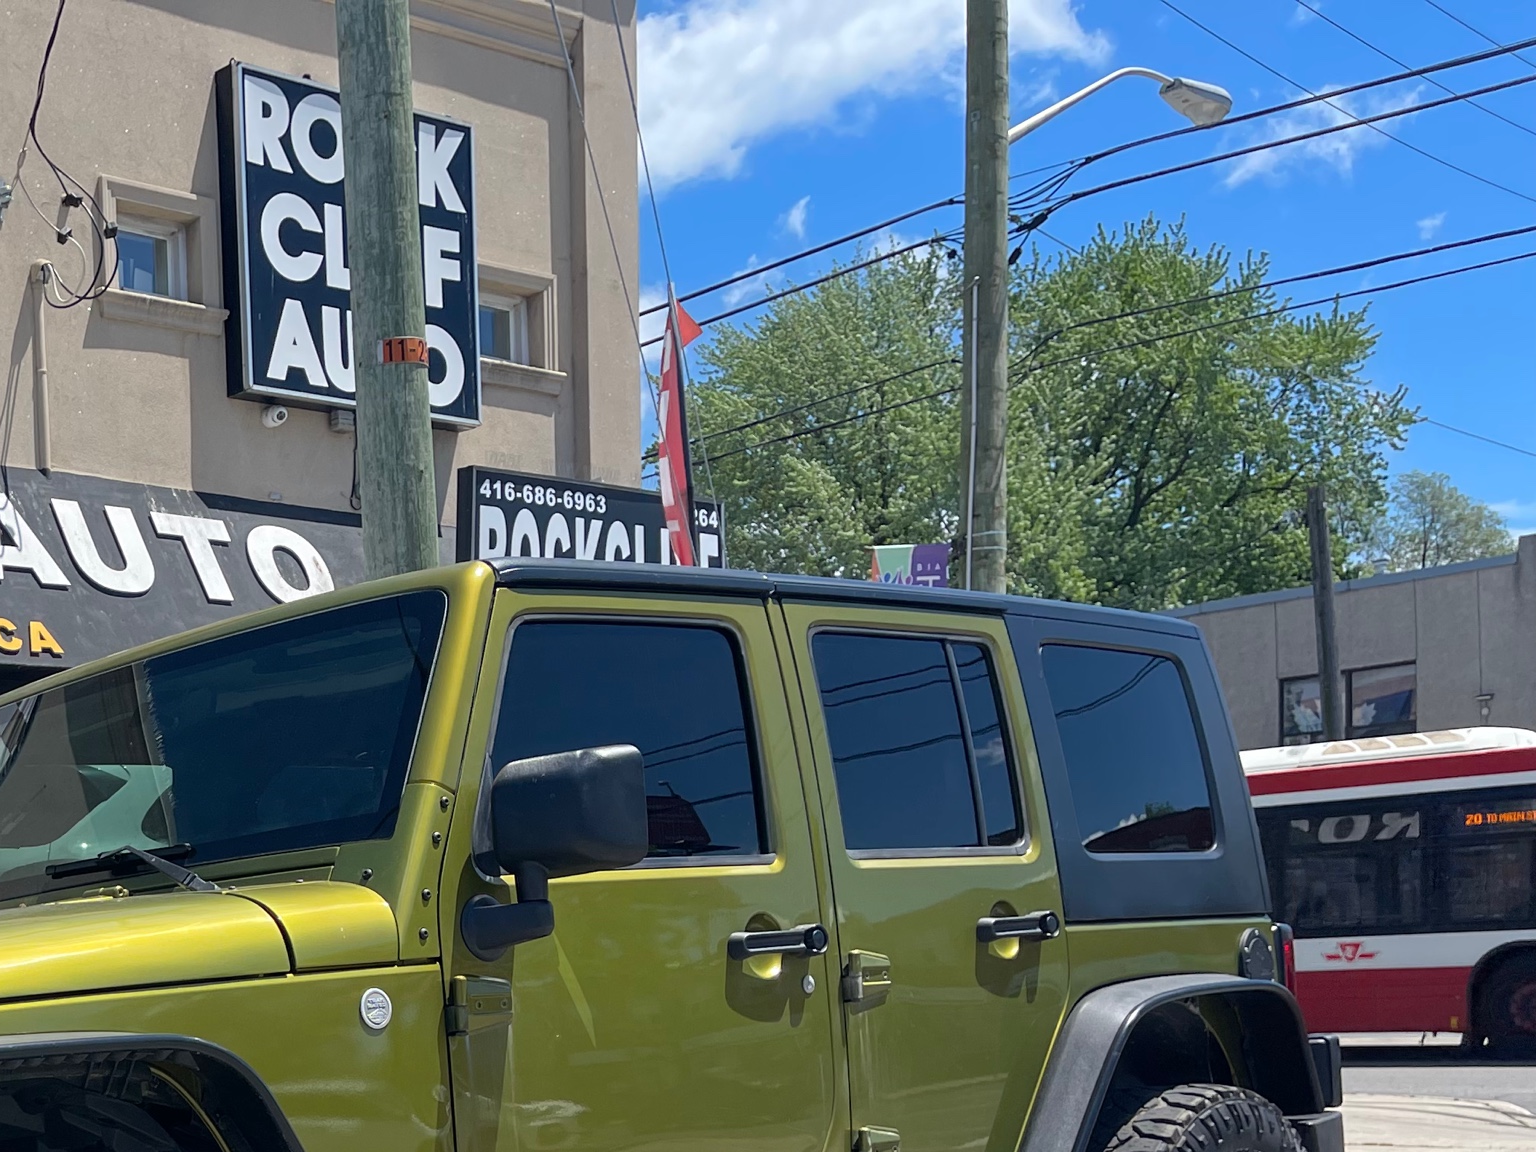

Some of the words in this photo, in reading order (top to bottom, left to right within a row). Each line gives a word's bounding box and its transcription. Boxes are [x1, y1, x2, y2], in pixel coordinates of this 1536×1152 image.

[244, 74, 467, 214] ROK
[260, 192, 462, 310] CLF
[266, 297, 465, 407] AUO
[479, 478, 607, 514] 416-686-6963
[1465, 812, 1483, 826] 20
[1486, 812, 1498, 824] TO
